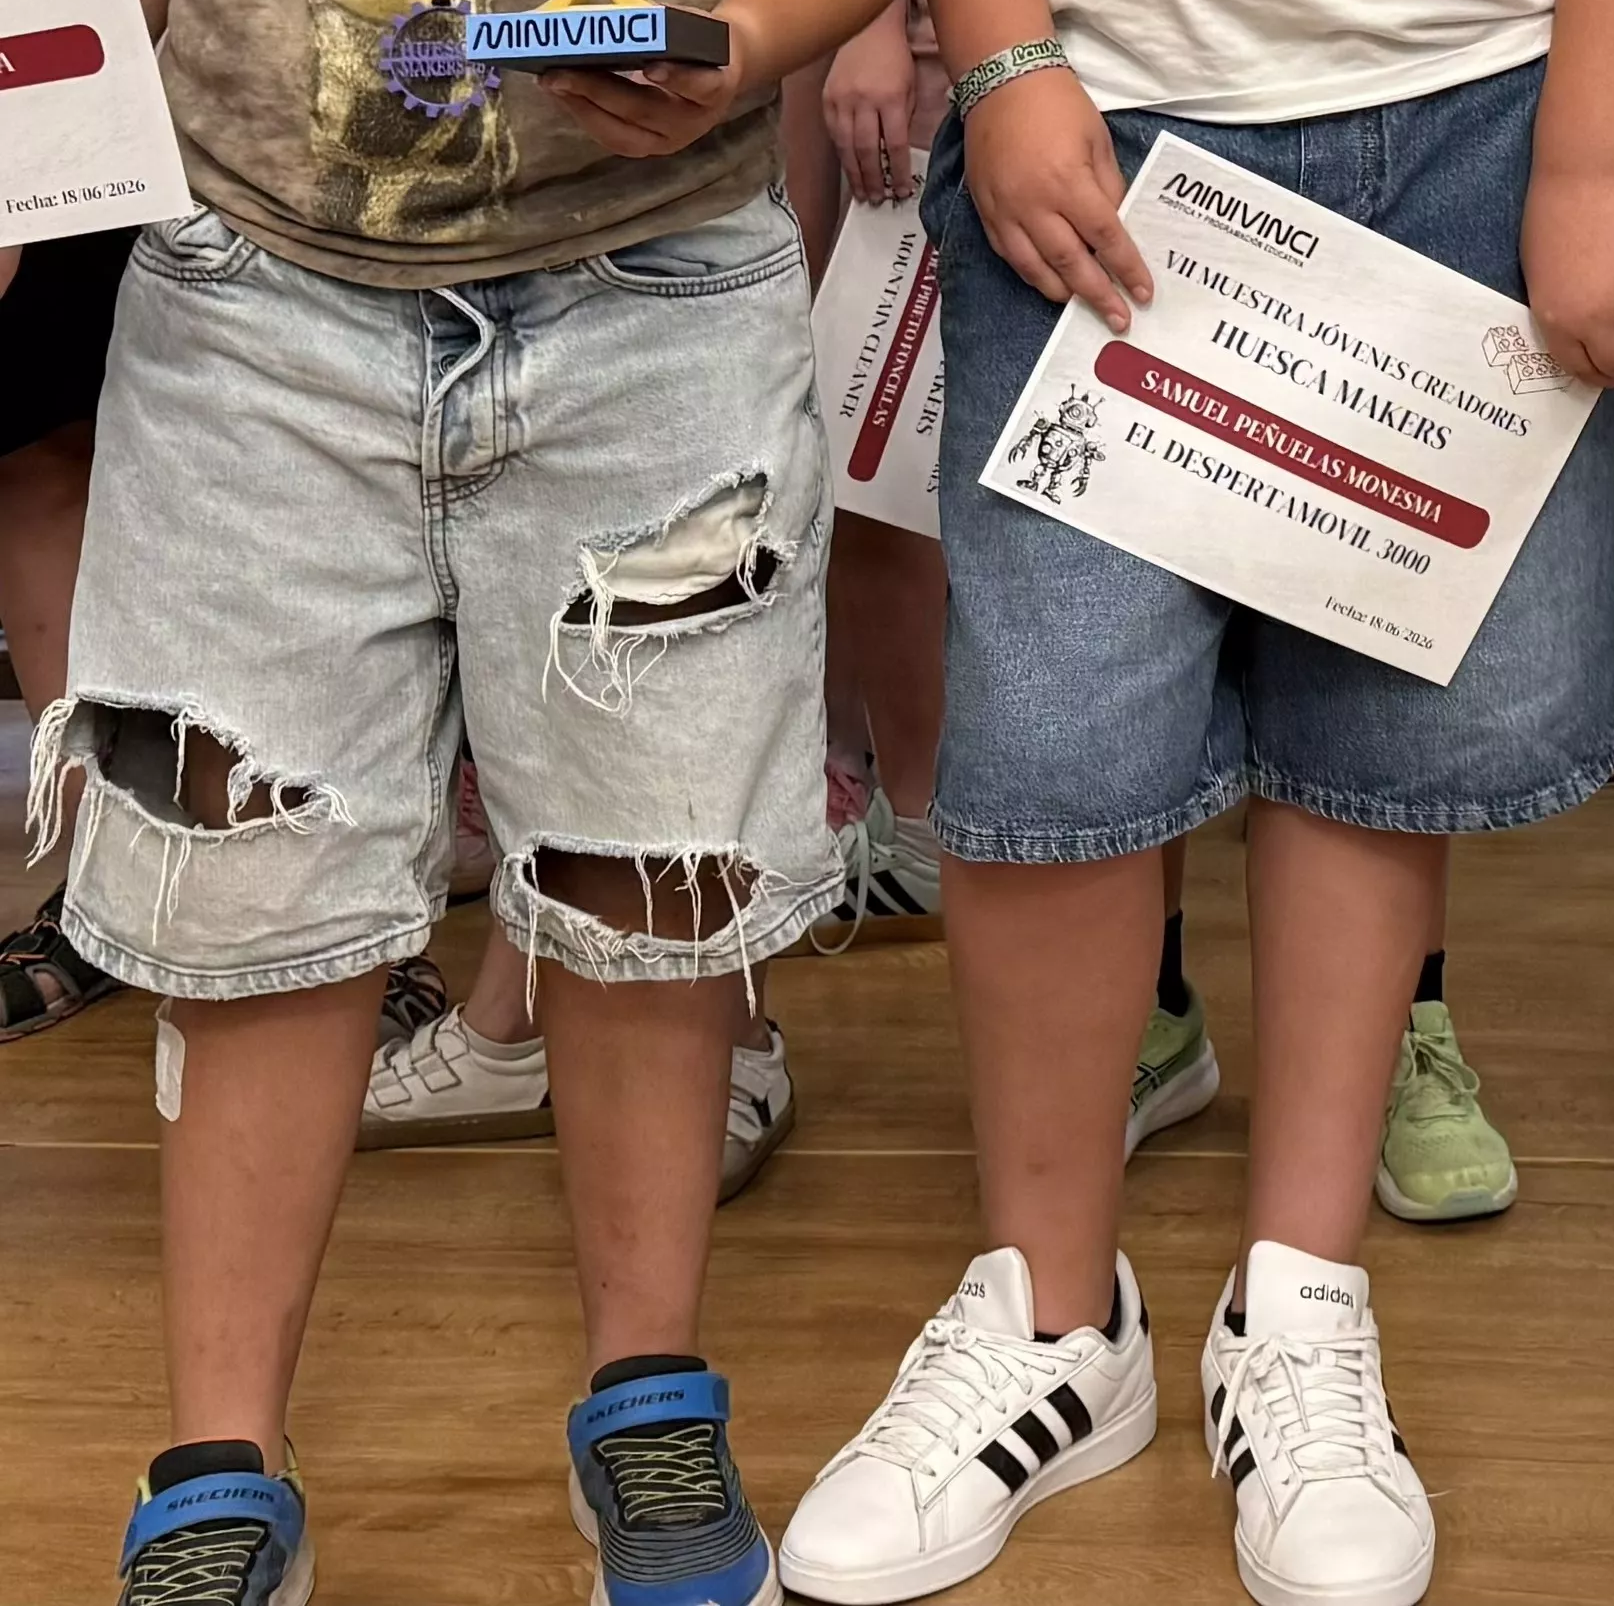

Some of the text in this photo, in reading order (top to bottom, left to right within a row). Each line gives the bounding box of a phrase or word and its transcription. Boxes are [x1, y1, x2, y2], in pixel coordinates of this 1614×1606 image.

[400, 41, 467, 59] HUESC
[472, 13, 657, 51] MINIVINCI
[6, 178, 146, 214] Fecha: 18/06/2026
[1162, 173, 1319, 259] MINIVINCI
[840, 232, 917, 419] MOUNTAIN CLEANER
[903, 284, 934, 342] PRIETO
[1166, 249, 1532, 438] VII MUESTRA JÓVENES CREADORES
[1210, 319, 1452, 451] HUESCA MAKERS
[1140, 369, 1443, 525] SAMUEL PEÑUELAS MONESMA
[1124, 421, 1431, 577] EL DESPERTAMOVIL 3000
[1325, 595, 1368, 624] Fecha:
[586, 1388, 685, 1424] SKECHERS
